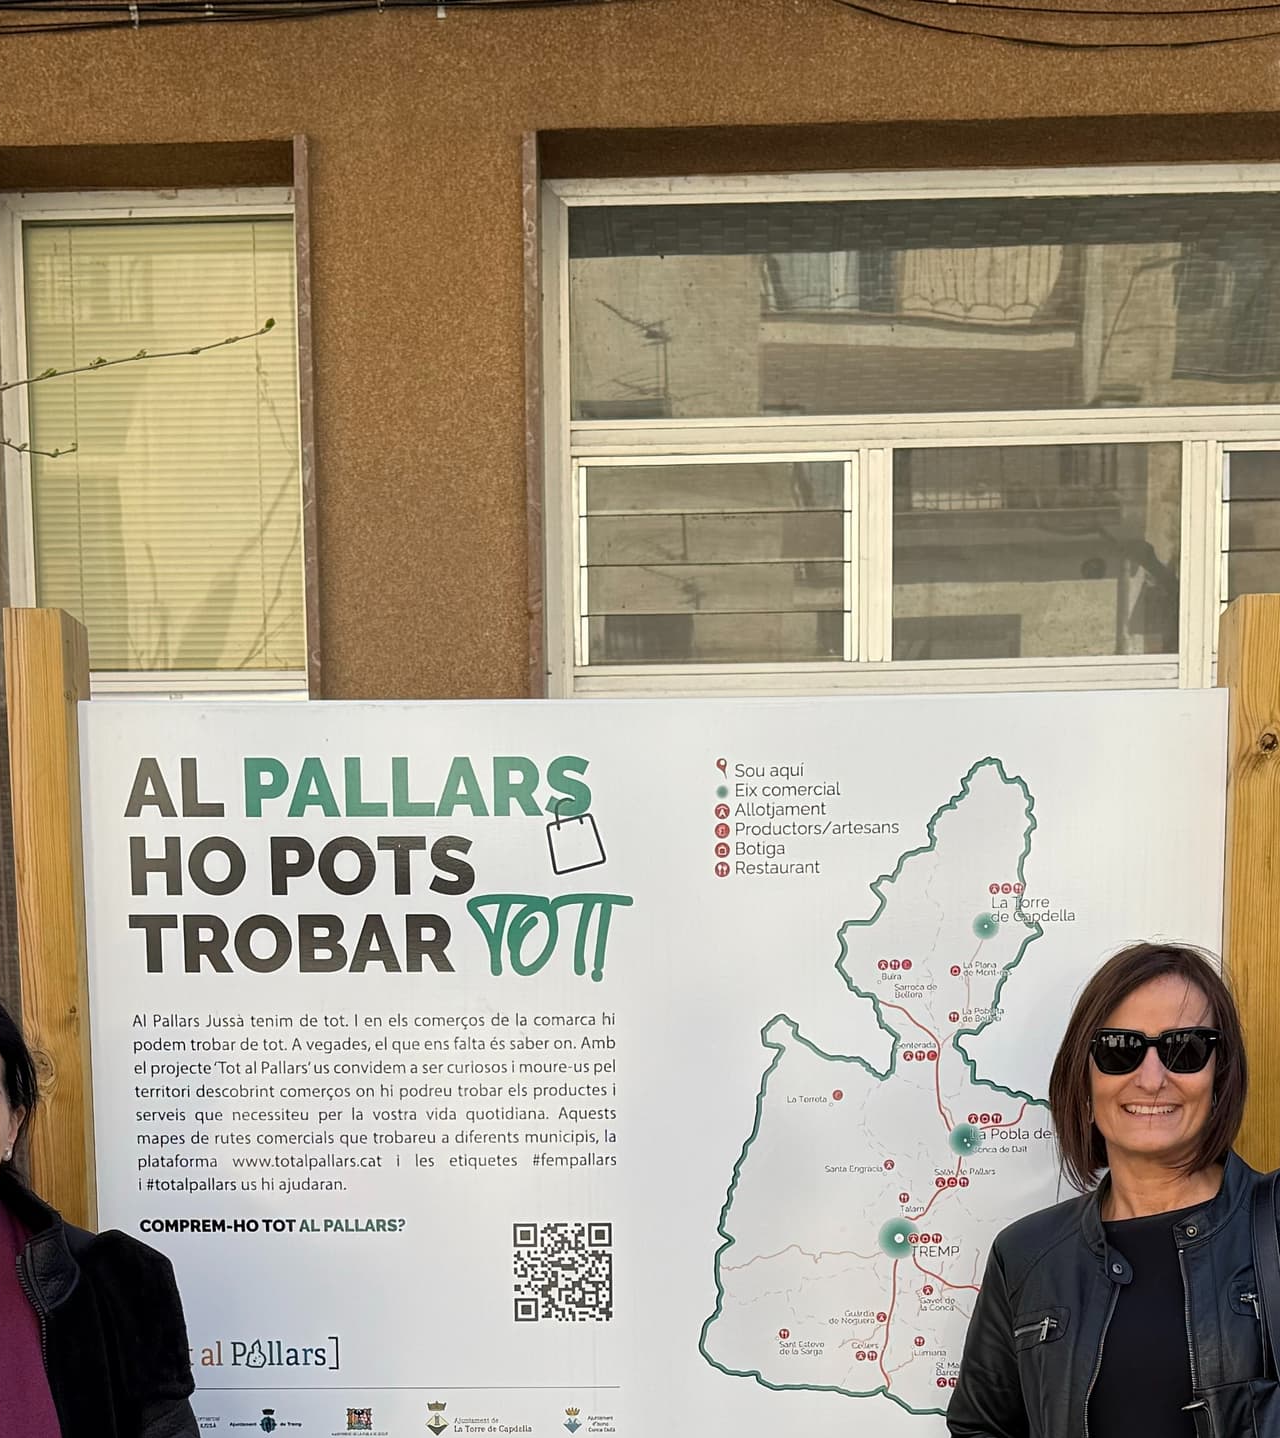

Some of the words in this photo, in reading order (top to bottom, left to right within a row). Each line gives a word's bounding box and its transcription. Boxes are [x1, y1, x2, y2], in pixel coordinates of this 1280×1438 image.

[734, 763, 765, 778] Sou
[769, 762, 805, 780] aquí
[123, 756, 225, 818] AL
[243, 755, 593, 818] PALLARS
[735, 783, 758, 797] Eix
[762, 781, 841, 797] comercial
[734, 802, 827, 819] Allotjament
[735, 821, 900, 836] Productors/artesans
[735, 841, 786, 859] Botiga
[129, 835, 247, 896] HO
[270, 834, 476, 896] POTS
[735, 860, 821, 875] Restaurant
[991, 896, 1008, 909] La
[1011, 896, 1050, 909] Torre
[990, 910, 1009, 923] de
[1013, 909, 1076, 923] Capdella
[128, 913, 456, 974] TROBAR
[132, 1012, 147, 1028] Al
[152, 1013, 201, 1028] Pallars
[205, 1013, 245, 1028] Jussà
[250, 1014, 293, 1028] tenim
[299, 1012, 319, 1028] de
[323, 1014, 349, 1028] tot.
[364, 1016, 383, 1028] en
[388, 1012, 409, 1028] els
[413, 1015, 486, 1031] comerços
[490, 1011, 510, 1027] de
[515, 1012, 528, 1027] la
[533, 1015, 596, 1027] comarca
[601, 1011, 616, 1026] hi
[133, 1036, 187, 1055] podem
[189, 1036, 237, 1052] trobar
[239, 1036, 259, 1052] de
[262, 1038, 288, 1052] tot.
[291, 1037, 303, 1052] A
[305, 1035, 372, 1056] vegades,
[374, 1035, 388, 1051] el
[391, 1040, 421, 1055] que
[423, 1039, 450, 1051] ens
[453, 1035, 486, 1051] falta
[489, 1036, 506, 1051] és
[509, 1035, 550, 1051] saber
[553, 1039, 577, 1050] on.
[580, 1034, 616, 1050] Amb
[133, 1059, 147, 1075] el
[150, 1060, 212, 1079] projecte
[244, 1060, 257, 1075] al
[313, 1063, 330, 1075] us
[333, 1059, 407, 1075] convidem
[409, 1063, 418, 1075] a
[421, 1063, 444, 1075] ser
[446, 1059, 508, 1074] curiosos
[519, 1062, 590, 1074] moure-us
[593, 1058, 616, 1077] pel
[134, 1084, 191, 1099] territori
[195, 1083, 276, 1099] descobrint
[279, 1087, 351, 1102] comerços
[355, 1087, 375, 1098] on
[380, 1083, 394, 1098] hi
[399, 1083, 452, 1101] podreu
[457, 1082, 504, 1098] trobar
[507, 1082, 528, 1097] els
[533, 1081, 608, 1101] productes
[135, 1107, 187, 1122] serveis
[194, 1111, 224, 1126] que
[232, 1107, 309, 1122] necessiteu
[318, 1110, 344, 1125] per
[351, 1106, 364, 1121] la
[372, 1108, 417, 1121] vostra
[425, 1106, 457, 1121] vida
[465, 1105, 550, 1124] quotidiana.
[557, 1105, 617, 1124] Aquests
[136, 1134, 186, 1149] mapes
[190, 1129, 210, 1145] de
[214, 1131, 252, 1145] rutes
[256, 1130, 335, 1145] comercials
[339, 1134, 368, 1149] que
[372, 1129, 436, 1145] trobareu
[441, 1133, 450, 1144] a
[454, 1129, 520, 1144] diferents
[524, 1129, 600, 1147] municipis,
[604, 1128, 617, 1143] la
[990, 1127, 1030, 1140] Pobla
[1033, 1127, 1053, 1140] de
[137, 1153, 218, 1172] plataforma
[231, 1153, 383, 1172] www.totalpallars.cat
[415, 1152, 435, 1168] les
[449, 1153, 518, 1171] etiquetes
[532, 1151, 617, 1170] #fempallars
[146, 1176, 237, 1195] #totalpallars
[240, 1180, 258, 1192] us
[261, 1176, 275, 1191] hi
[278, 1176, 348, 1195] ajudaran.
[139, 1218, 260, 1233] COMPREM-HO
[261, 1218, 297, 1233] TOT
[298, 1218, 321, 1233] AL
[323, 1218, 407, 1233] PALLARS?
[912, 1245, 961, 1258] TREMP
[200, 1340, 224, 1367] al
